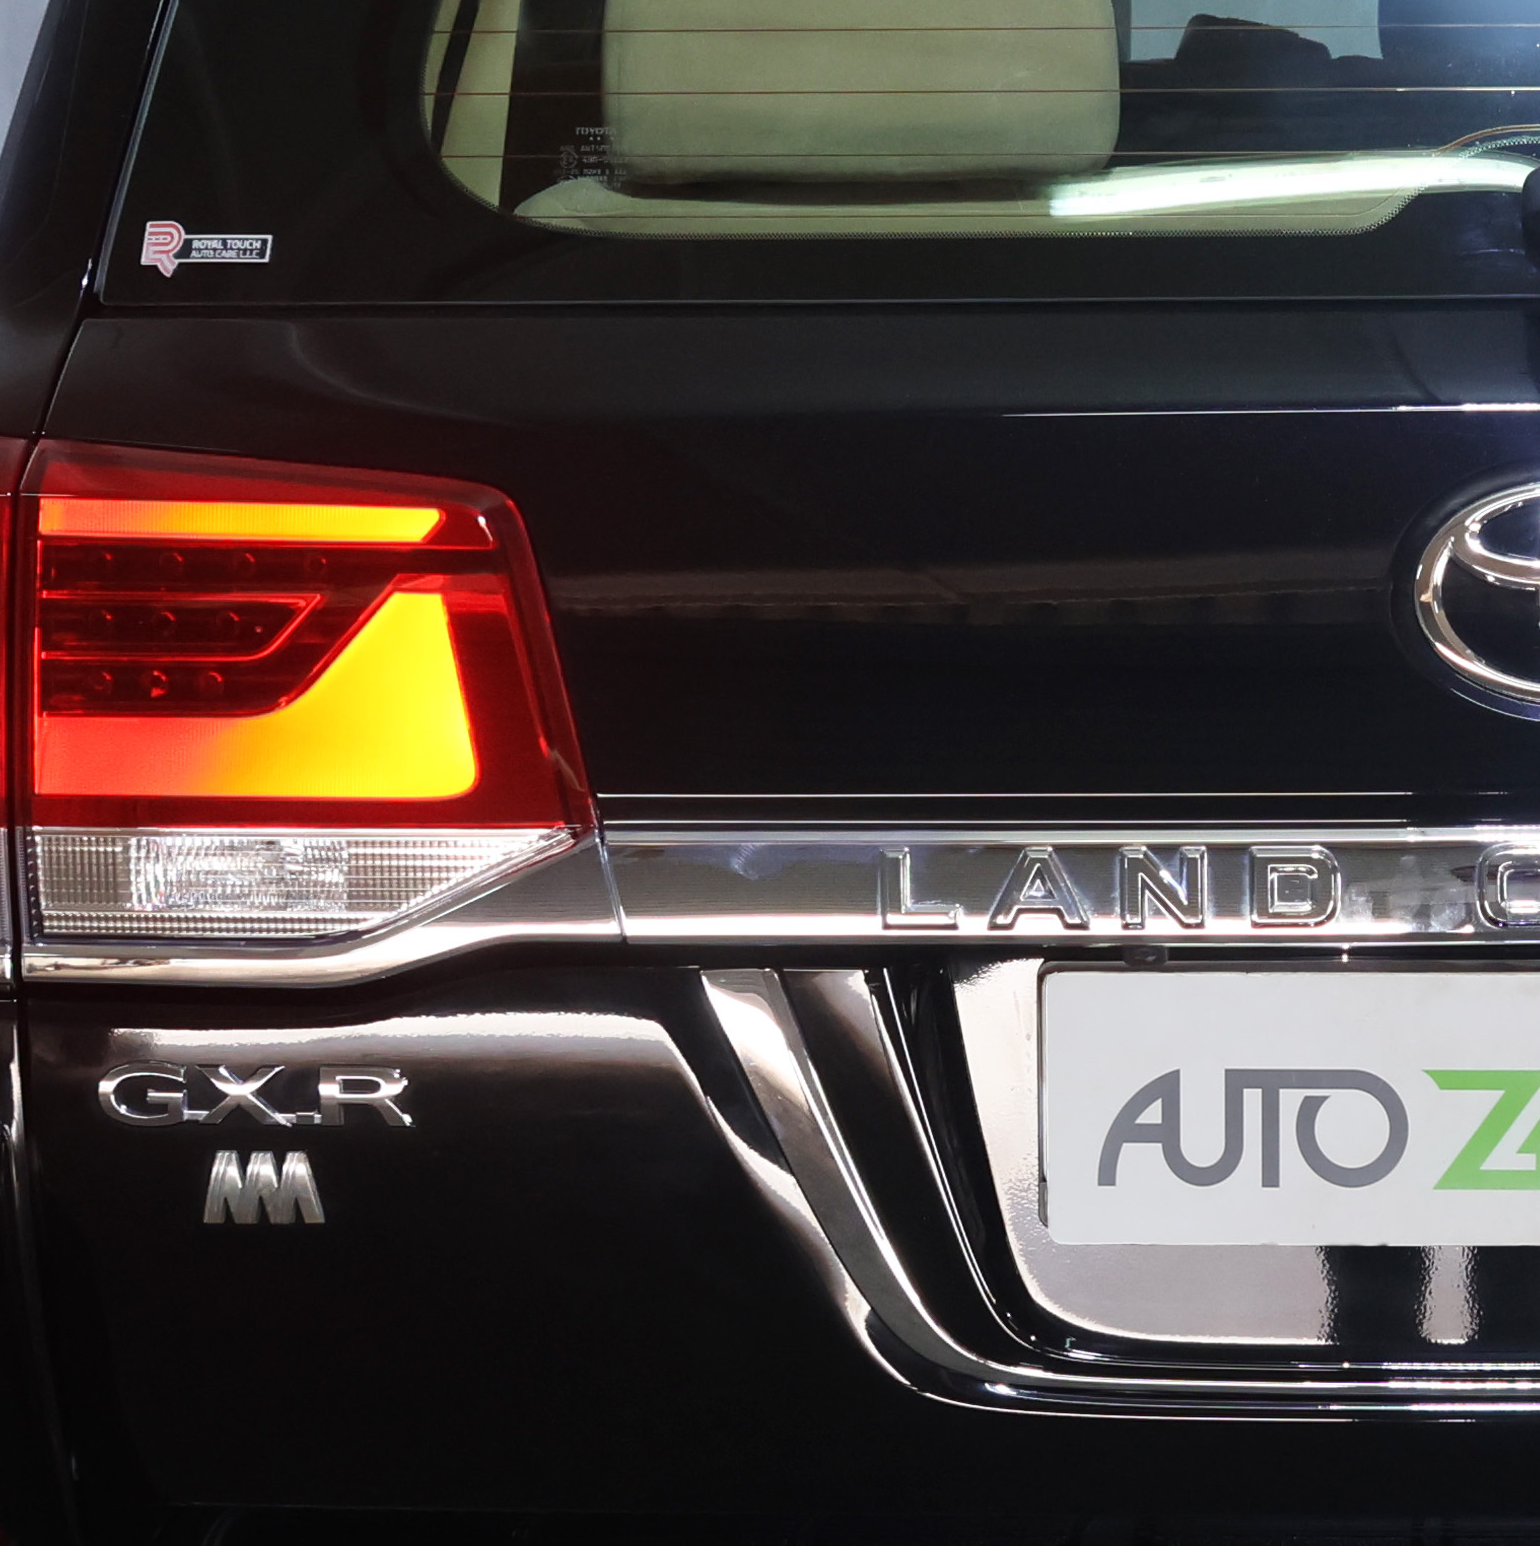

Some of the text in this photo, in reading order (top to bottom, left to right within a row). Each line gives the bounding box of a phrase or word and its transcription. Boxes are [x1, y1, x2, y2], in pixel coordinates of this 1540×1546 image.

[190, 250, 214, 259] AUTO
[215, 250, 238, 259] CARE
[191, 239, 262, 249] ROYAL TOUCH
[878, 845, 1343, 931] LAND
[98, 1059, 415, 1127] GXR
[1097, 1067, 1410, 1189] AUTO
